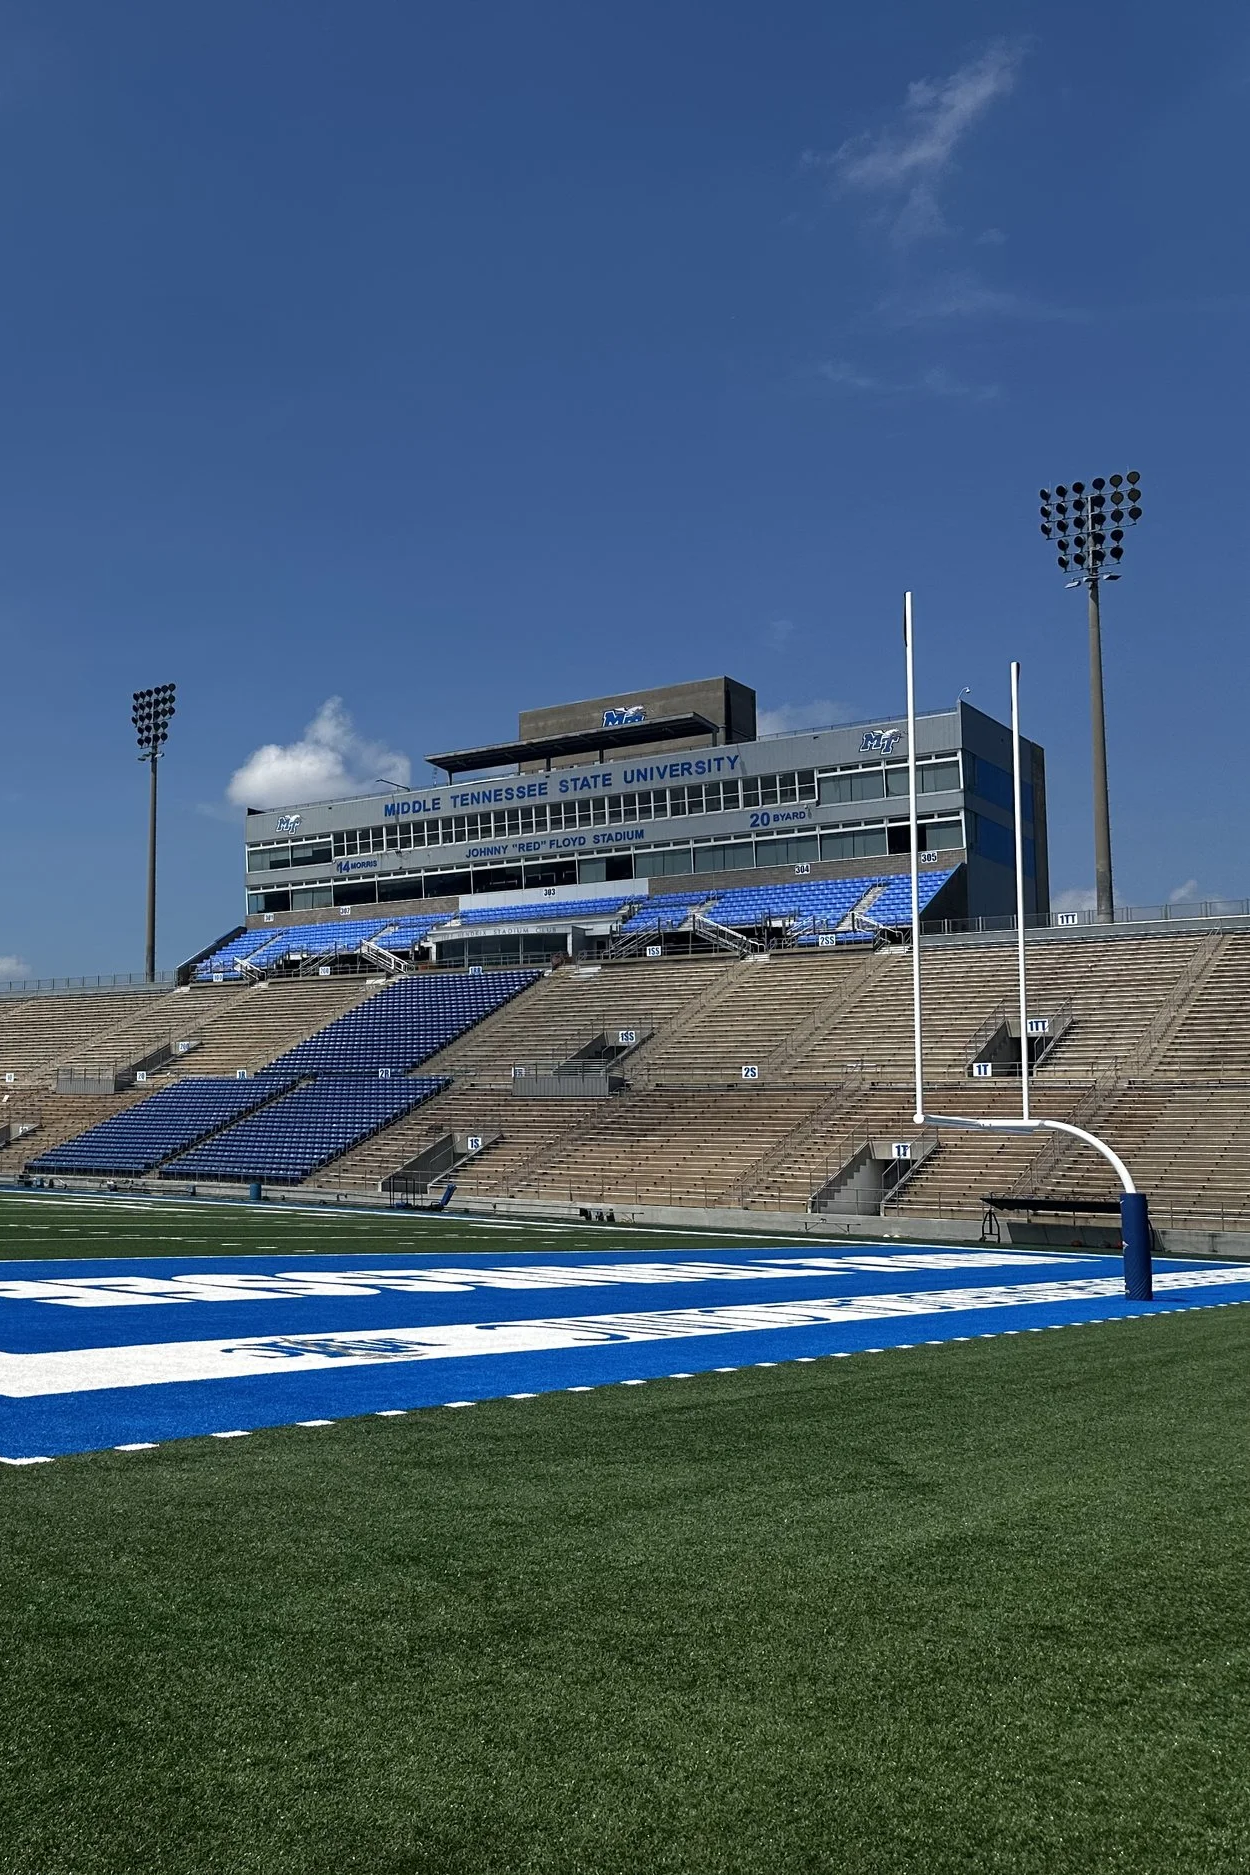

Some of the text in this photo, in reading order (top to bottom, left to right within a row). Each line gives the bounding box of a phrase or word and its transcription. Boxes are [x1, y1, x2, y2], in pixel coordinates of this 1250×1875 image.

[384, 754, 740, 818] MIDDLE TENNESSEE STATE UNIVERSITY
[750, 810, 806, 828] 20 BYARD
[465, 844, 509, 859] JOHNNY
[549, 835, 587, 851] FLOYD
[592, 829, 645, 845] STADIUM
[921, 852, 937, 863] 305
[336, 860, 378, 873] 14 MORRIS
[795, 864, 810, 874] 304
[543, 888, 556, 897] 303
[1059, 913, 1076, 924] 1TT
[493, 927, 529, 935] STADIUM
[535, 926, 557, 934] CLUB
[819, 935, 835, 945] 2SS
[647, 947, 660, 956] 1SS
[1028, 1020, 1047, 1031] 1TT
[620, 1032, 635, 1041] 1SS
[379, 1069, 390, 1078] 2R
[743, 1066, 757, 1077] 2S
[976, 1063, 989, 1075] 1T
[469, 1138, 480, 1148] 1S
[895, 1144, 909, 1157] 1T
